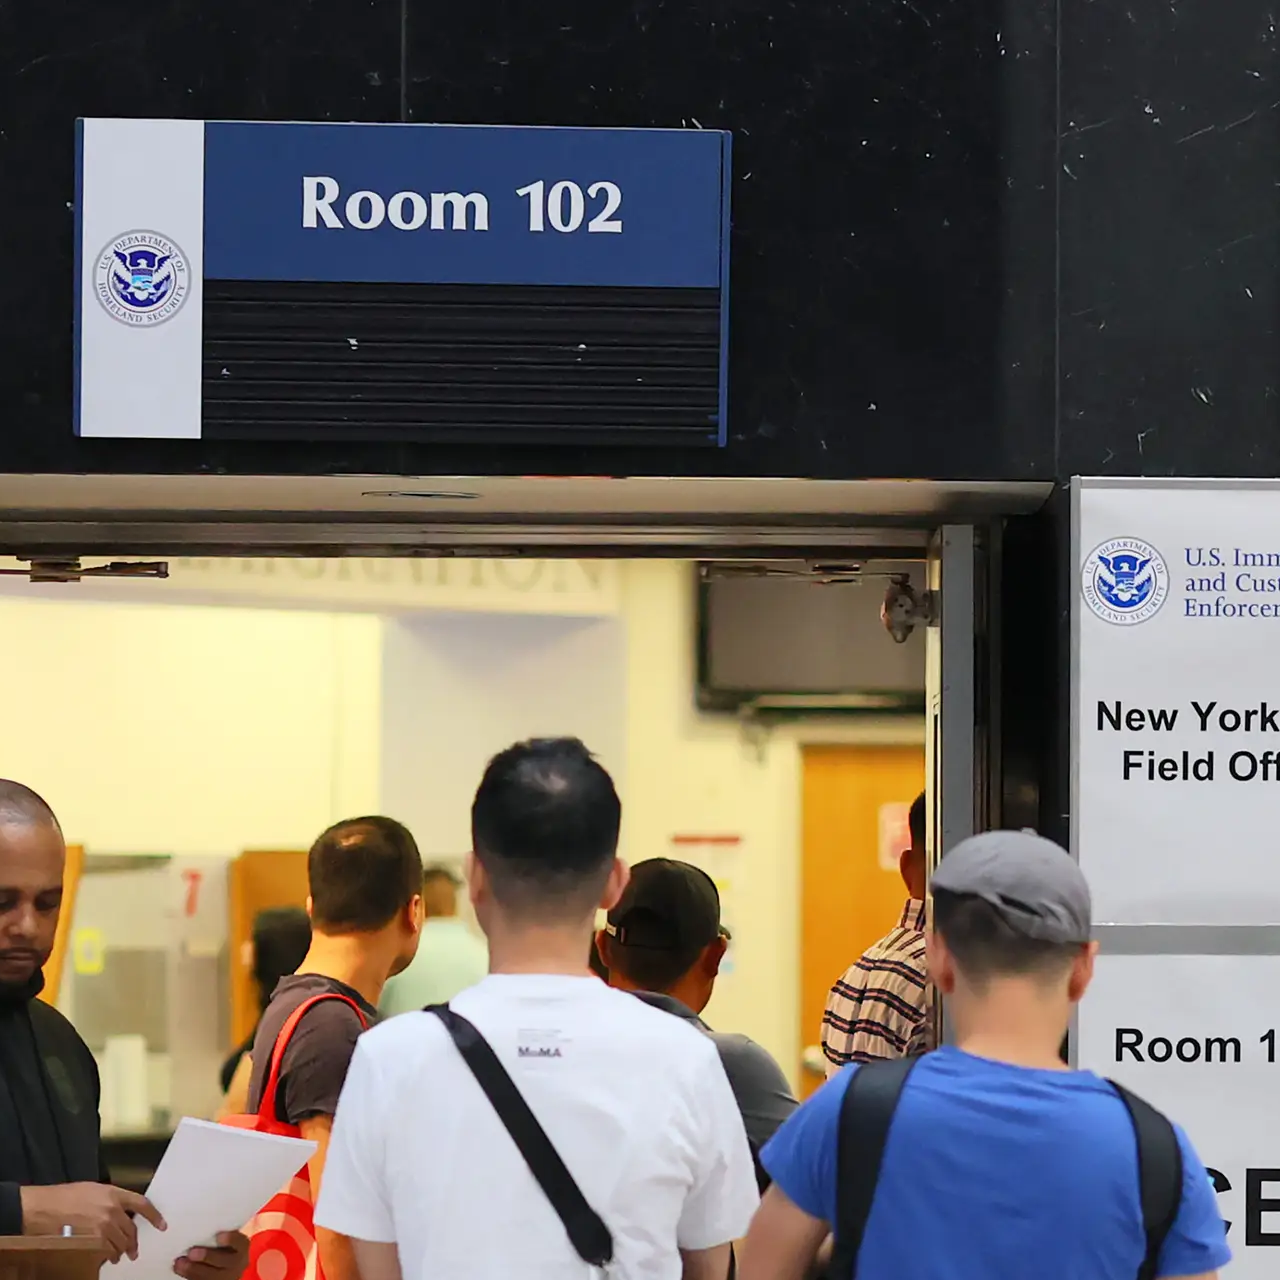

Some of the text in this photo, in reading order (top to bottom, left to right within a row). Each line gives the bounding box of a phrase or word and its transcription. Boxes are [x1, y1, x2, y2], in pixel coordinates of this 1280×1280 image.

[301, 176, 623, 233] Room 102
[115, 235, 177, 260] DEPARTMENT
[98, 282, 186, 322] HOMELAND SECURITY
[1184, 548, 1226, 567] U.S.
[1185, 573, 1226, 592] and
[1085, 585, 1165, 621] HOMELAND SECURITY
[1097, 701, 1179, 732] New
[1190, 702, 1280, 732] York
[1122, 750, 1215, 781] Field
[1115, 1028, 1241, 1063] Room
